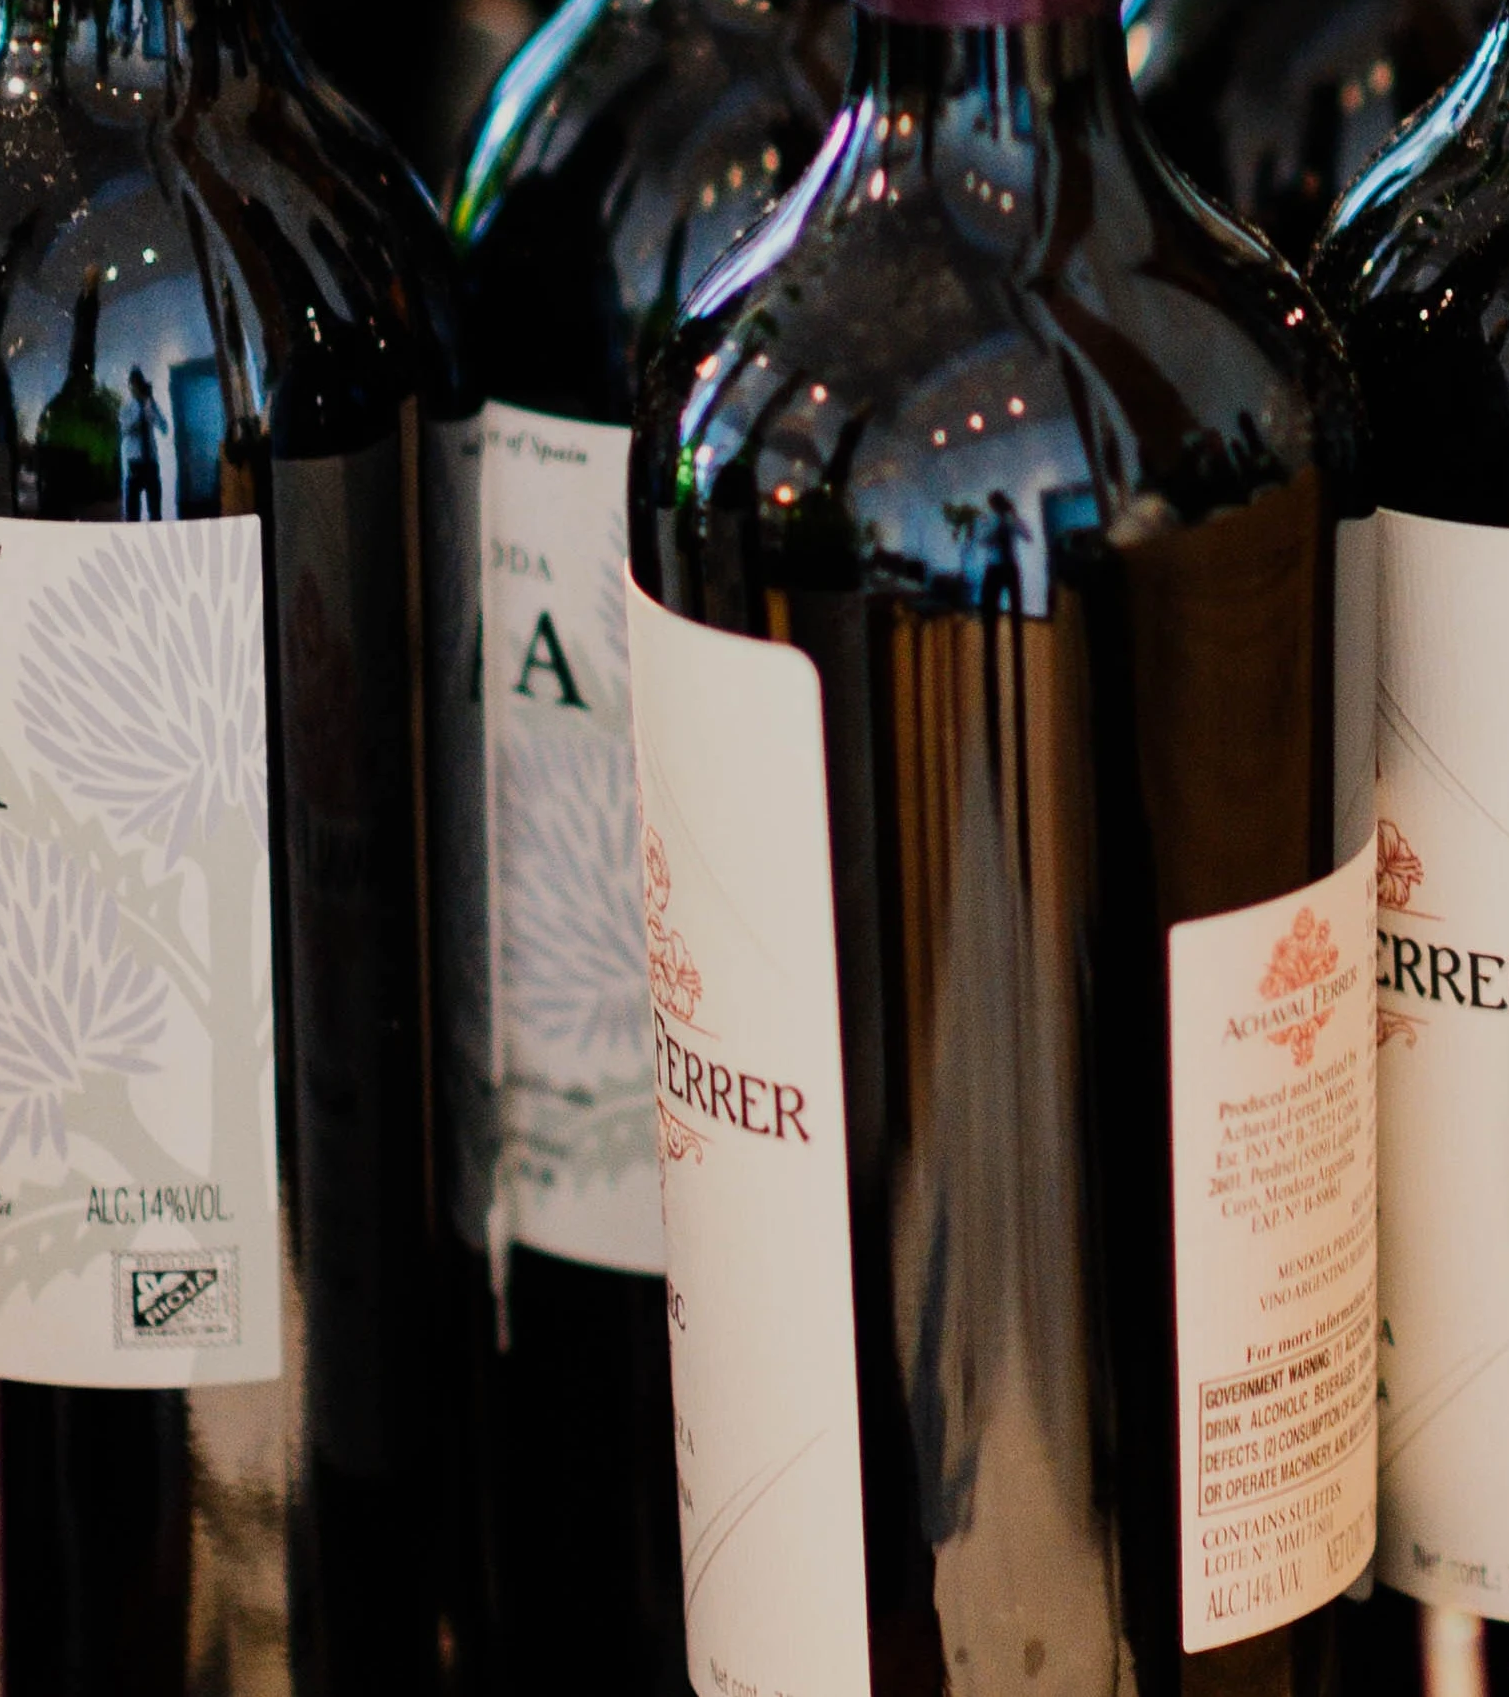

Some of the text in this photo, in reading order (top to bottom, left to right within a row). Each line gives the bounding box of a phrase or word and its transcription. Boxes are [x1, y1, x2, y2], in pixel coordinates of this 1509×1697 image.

[653, 1006, 811, 1143] FERRER
[1246, 1344, 1273, 1364] For
[1277, 1329, 1312, 1354] more
[1205, 1369, 1284, 1411] GOVERNMENT
[1205, 1412, 1242, 1443] DRINK
[1250, 1389, 1309, 1432] ALCOHOLIC
[1204, 1483, 1223, 1506] OR
[1226, 1467, 1278, 1502] OPERATE
[1202, 1505, 1286, 1551] CONTAINS
